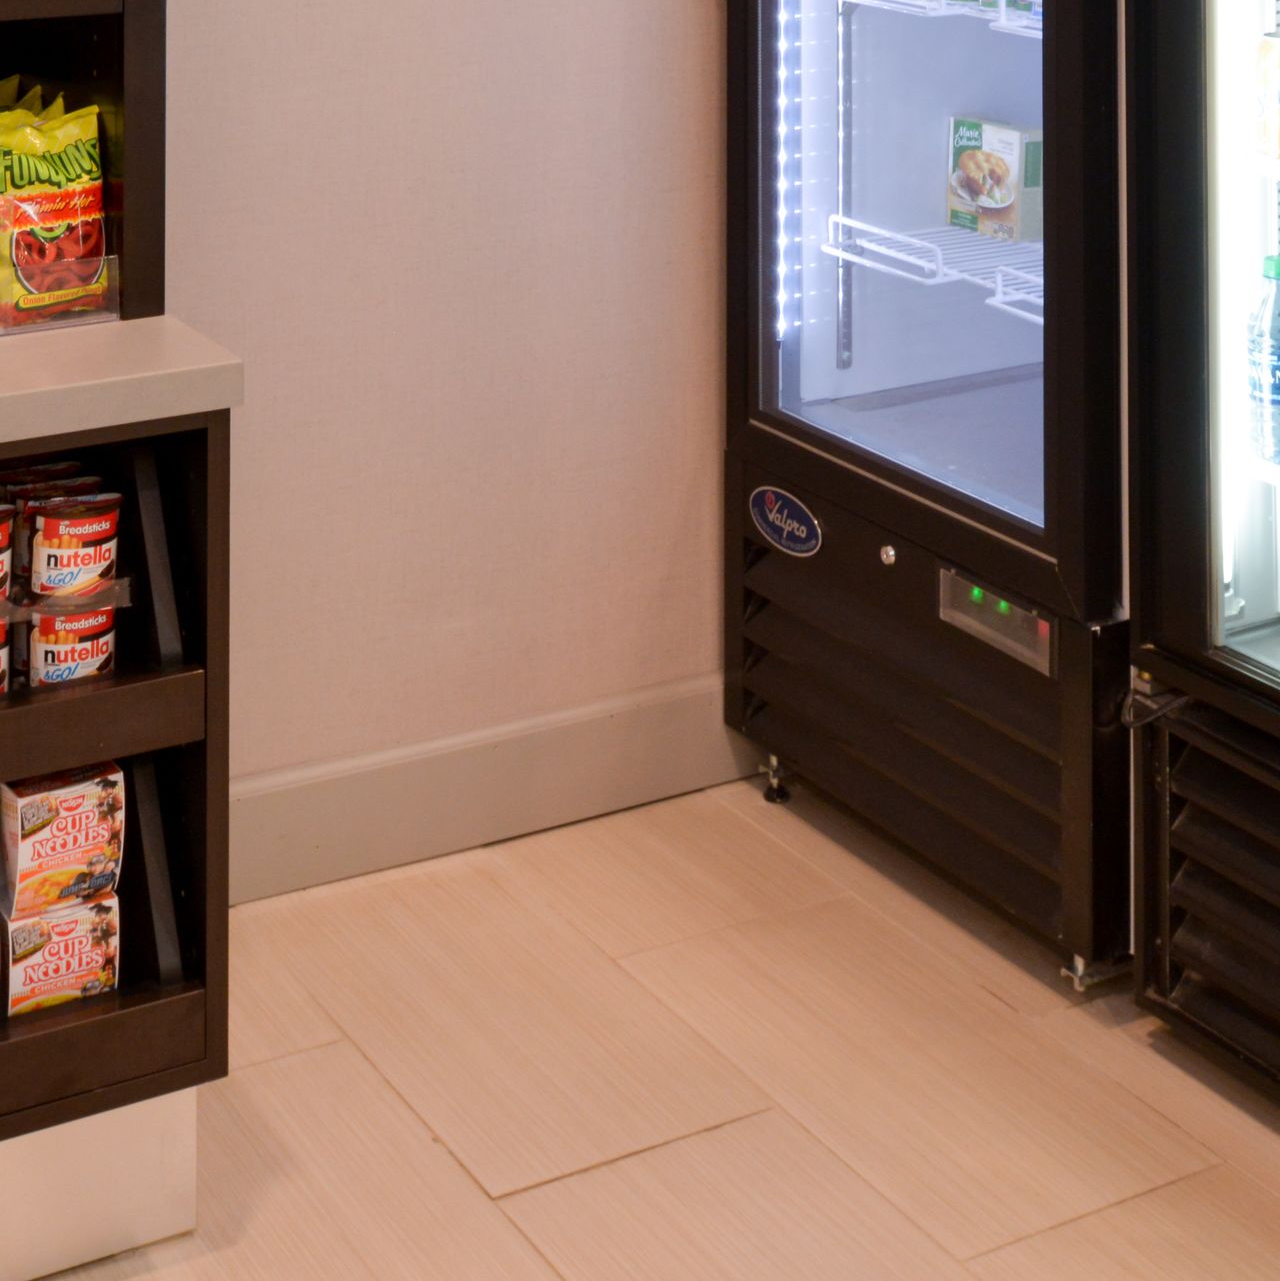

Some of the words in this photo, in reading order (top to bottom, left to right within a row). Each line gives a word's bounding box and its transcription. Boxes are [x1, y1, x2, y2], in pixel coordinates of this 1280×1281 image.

[59, 521, 111, 535] Breadsticks
[765, 500, 807, 538] Valpro
[46, 546, 112, 568] nutella
[55, 615, 107, 631] Breadsticks
[44, 640, 109, 665] nutella
[50, 809, 96, 836] CUP
[31, 822, 112, 861] NOODLES
[41, 935, 88, 962] CUP
[23, 948, 105, 987] NOODLES
